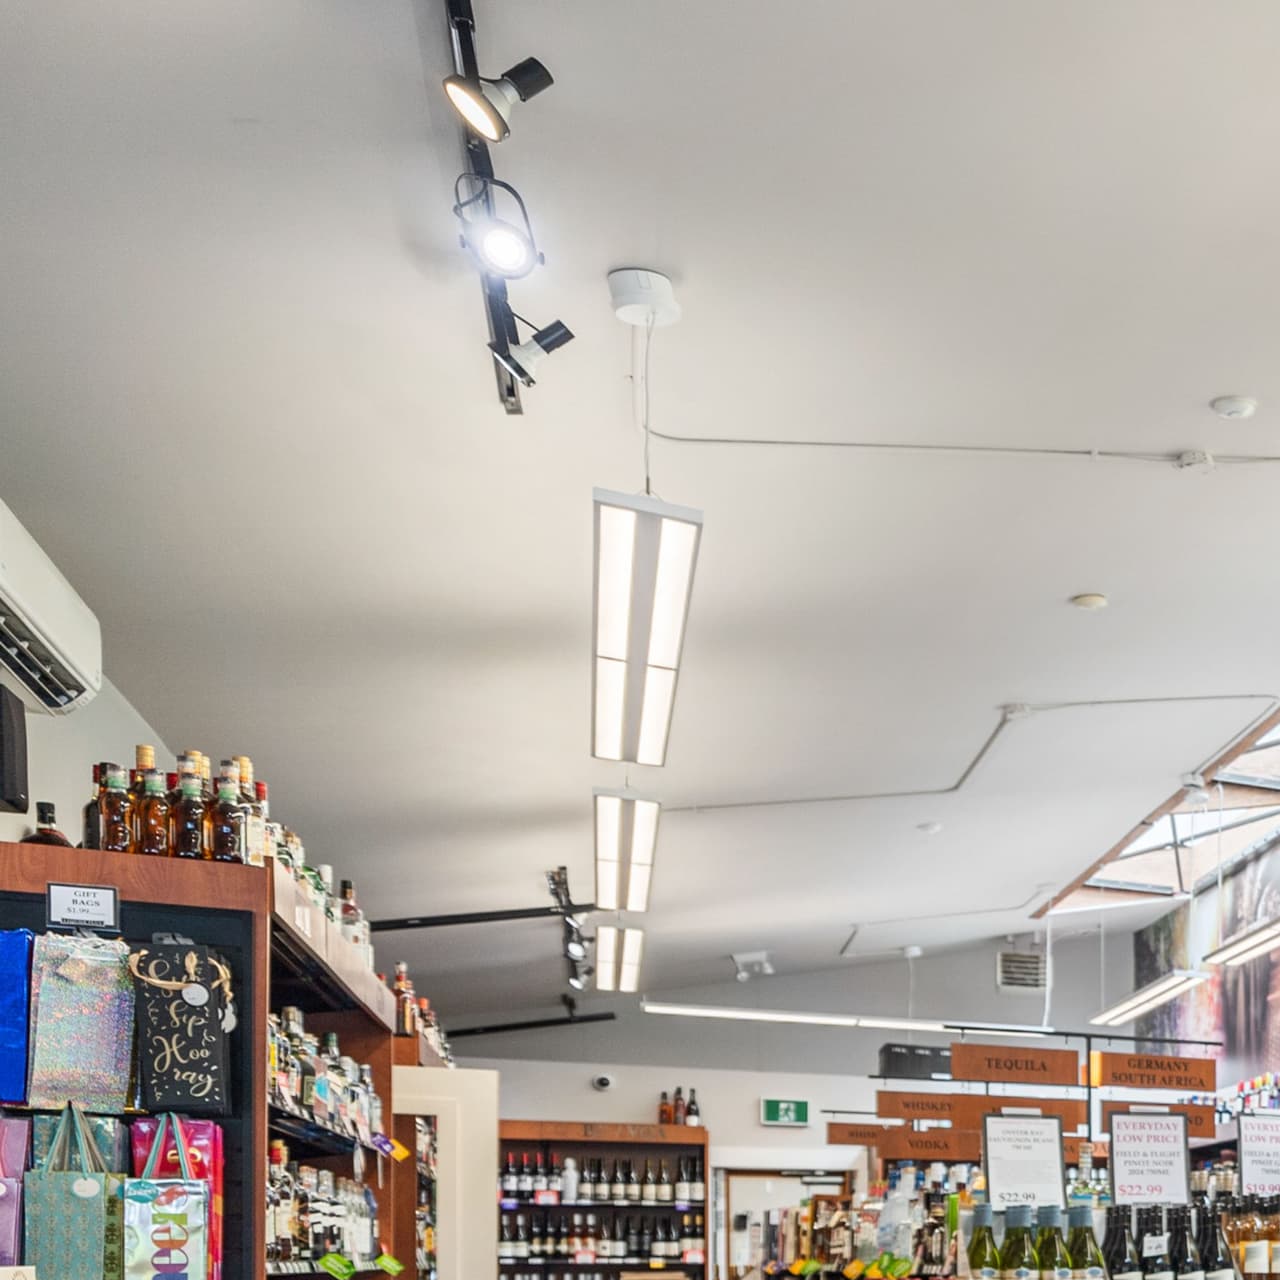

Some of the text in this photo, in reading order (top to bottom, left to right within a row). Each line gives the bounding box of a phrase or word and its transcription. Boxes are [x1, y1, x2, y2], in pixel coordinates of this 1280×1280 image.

[74, 890, 98, 899] GIFT
[72, 898, 100, 907] BAGS
[985, 1057, 1048, 1072] TEQUILA
[1127, 1058, 1190, 1072] GERMANY
[1112, 1072, 1206, 1088] SOUTH AFRICA
[902, 1100, 952, 1112] WHISKEY
[1116, 1121, 1179, 1131] EVERYDAY
[908, 1138, 949, 1150] VODKA
[1116, 1134, 1179, 1144] LOW PRICE
[1119, 1185, 1162, 1196] $22.99
[1246, 1184, 1280, 1194] $19.99
[999, 1192, 1036, 1202] $22.99
